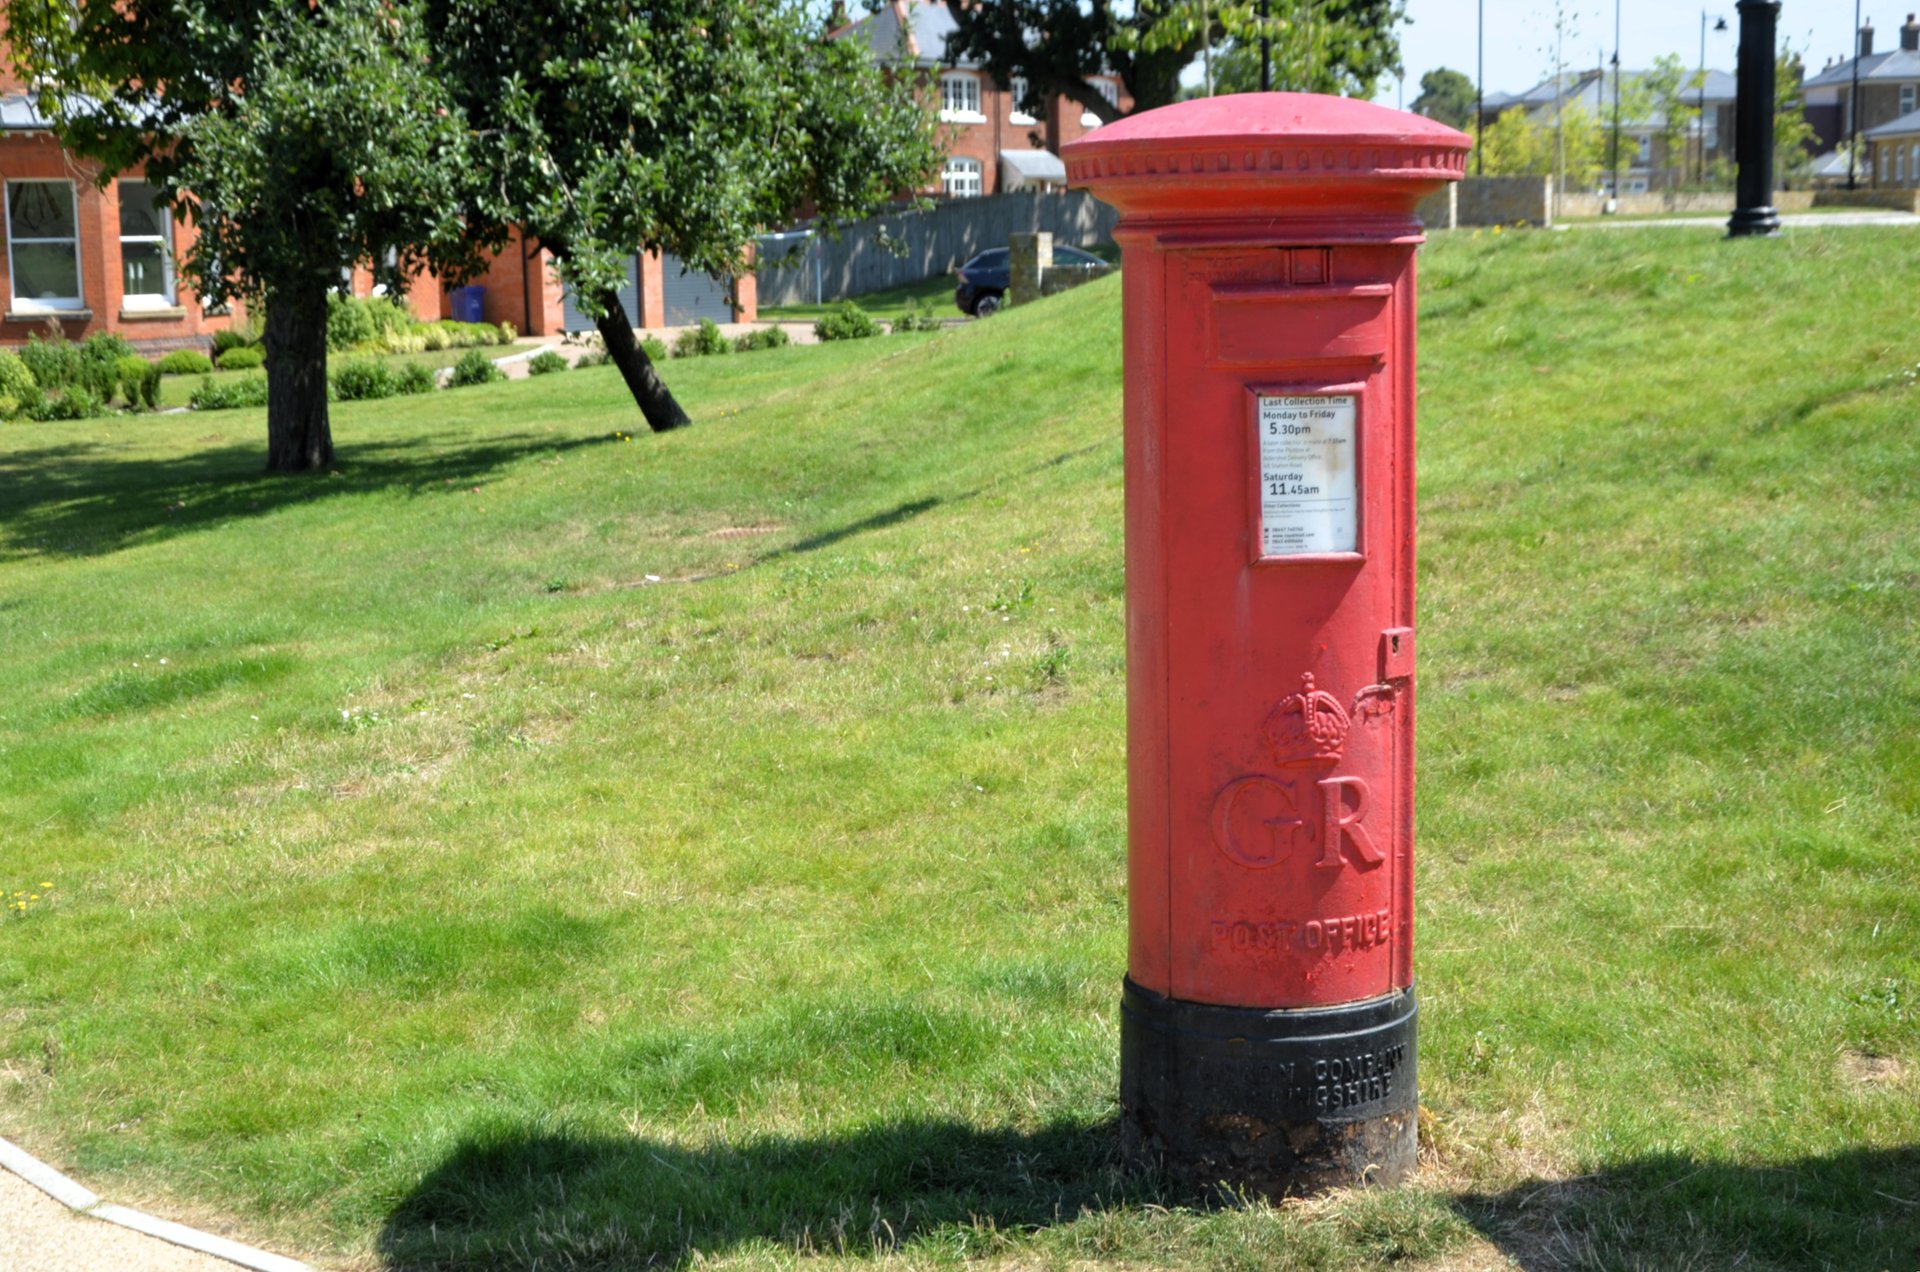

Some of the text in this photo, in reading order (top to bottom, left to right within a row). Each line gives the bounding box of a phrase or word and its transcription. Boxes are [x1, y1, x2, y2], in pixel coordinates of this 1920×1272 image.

[1263, 396, 1348, 407] Last Collection Time
[1263, 409, 1336, 421] Monday to Friday
[1269, 422, 1312, 436] 5.30pm
[1263, 472, 1304, 482] Saturday
[1269, 482, 1320, 496] 11.45am
[1210, 919, 1297, 951] POST
[1304, 908, 1391, 949] OFFICE
